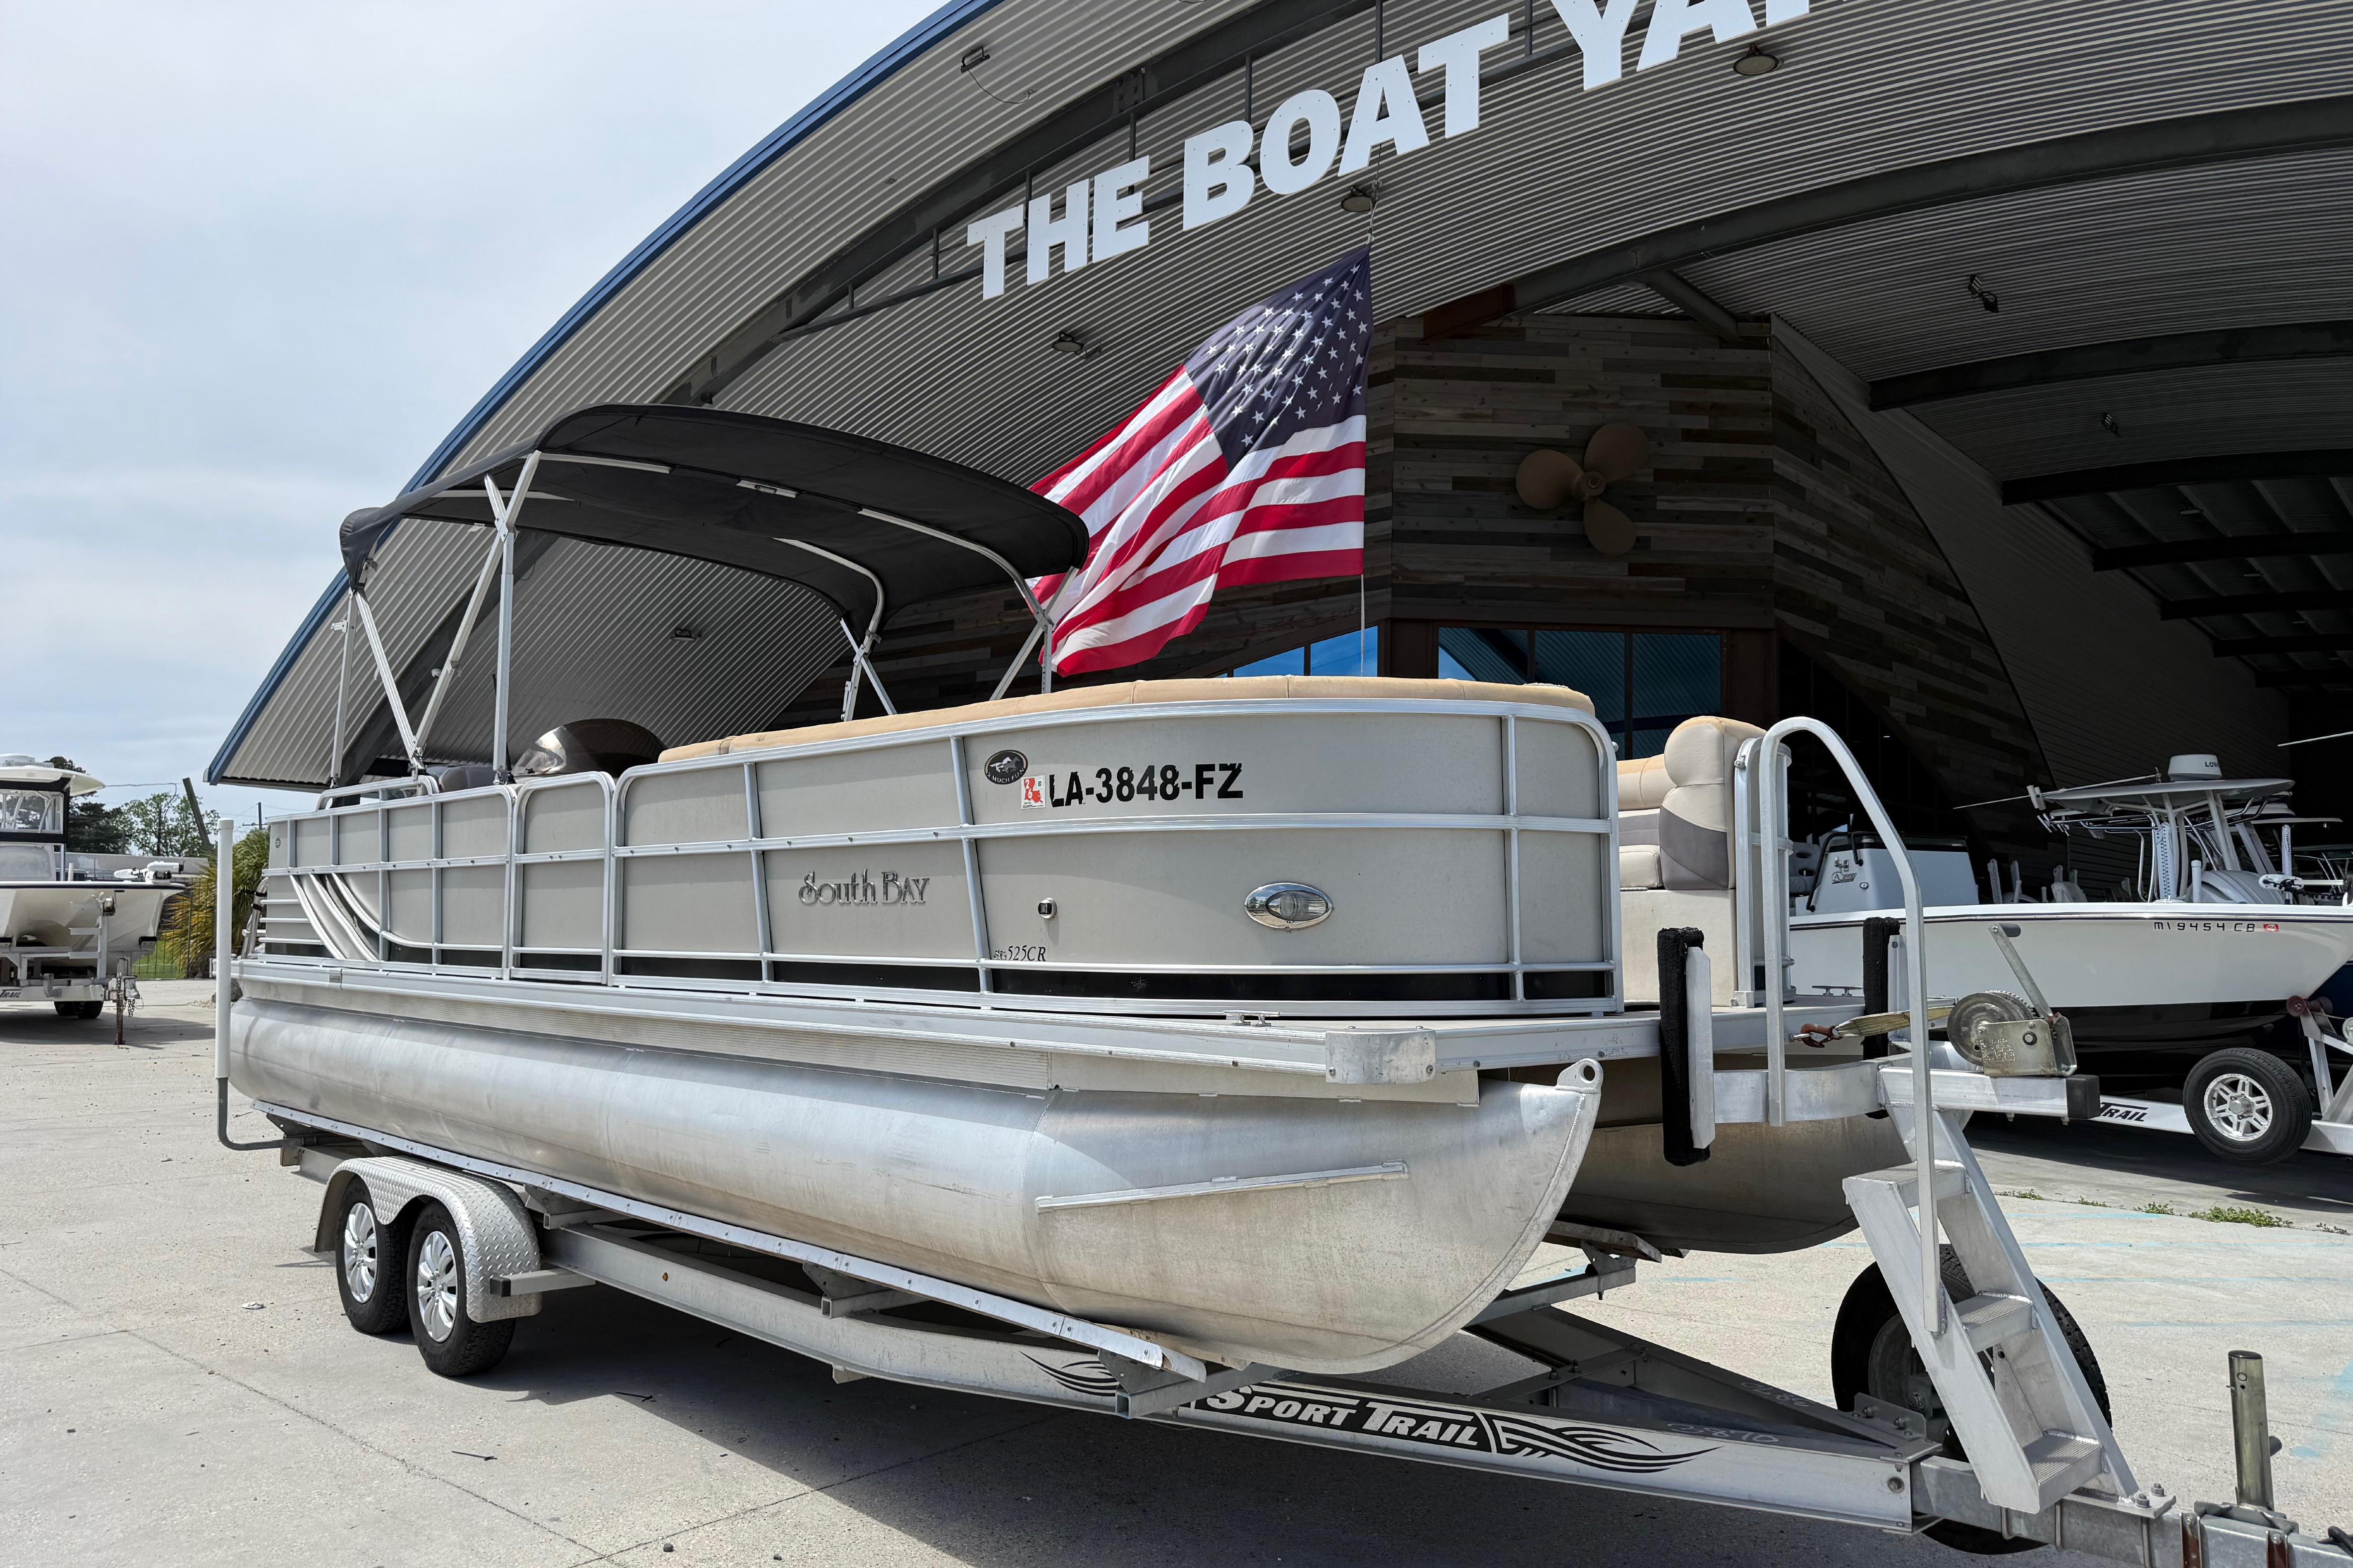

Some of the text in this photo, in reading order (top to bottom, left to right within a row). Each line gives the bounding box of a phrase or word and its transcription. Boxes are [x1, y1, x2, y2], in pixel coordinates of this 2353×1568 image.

[967, 155, 1149, 300] THE
[1182, 12, 1509, 231] BOAT
[992, 775, 1010, 784] MUCH
[1012, 767, 1024, 781] FUN
[1049, 763, 1243, 807] LA-3848-FZ
[799, 868, 878, 904] South
[2177, 922, 2225, 931] 9454
[2234, 923, 2255, 932] CB
[2100, 1102, 2148, 1122] TRAIL
[1206, 1386, 1478, 1446] SPORT TRAIL
